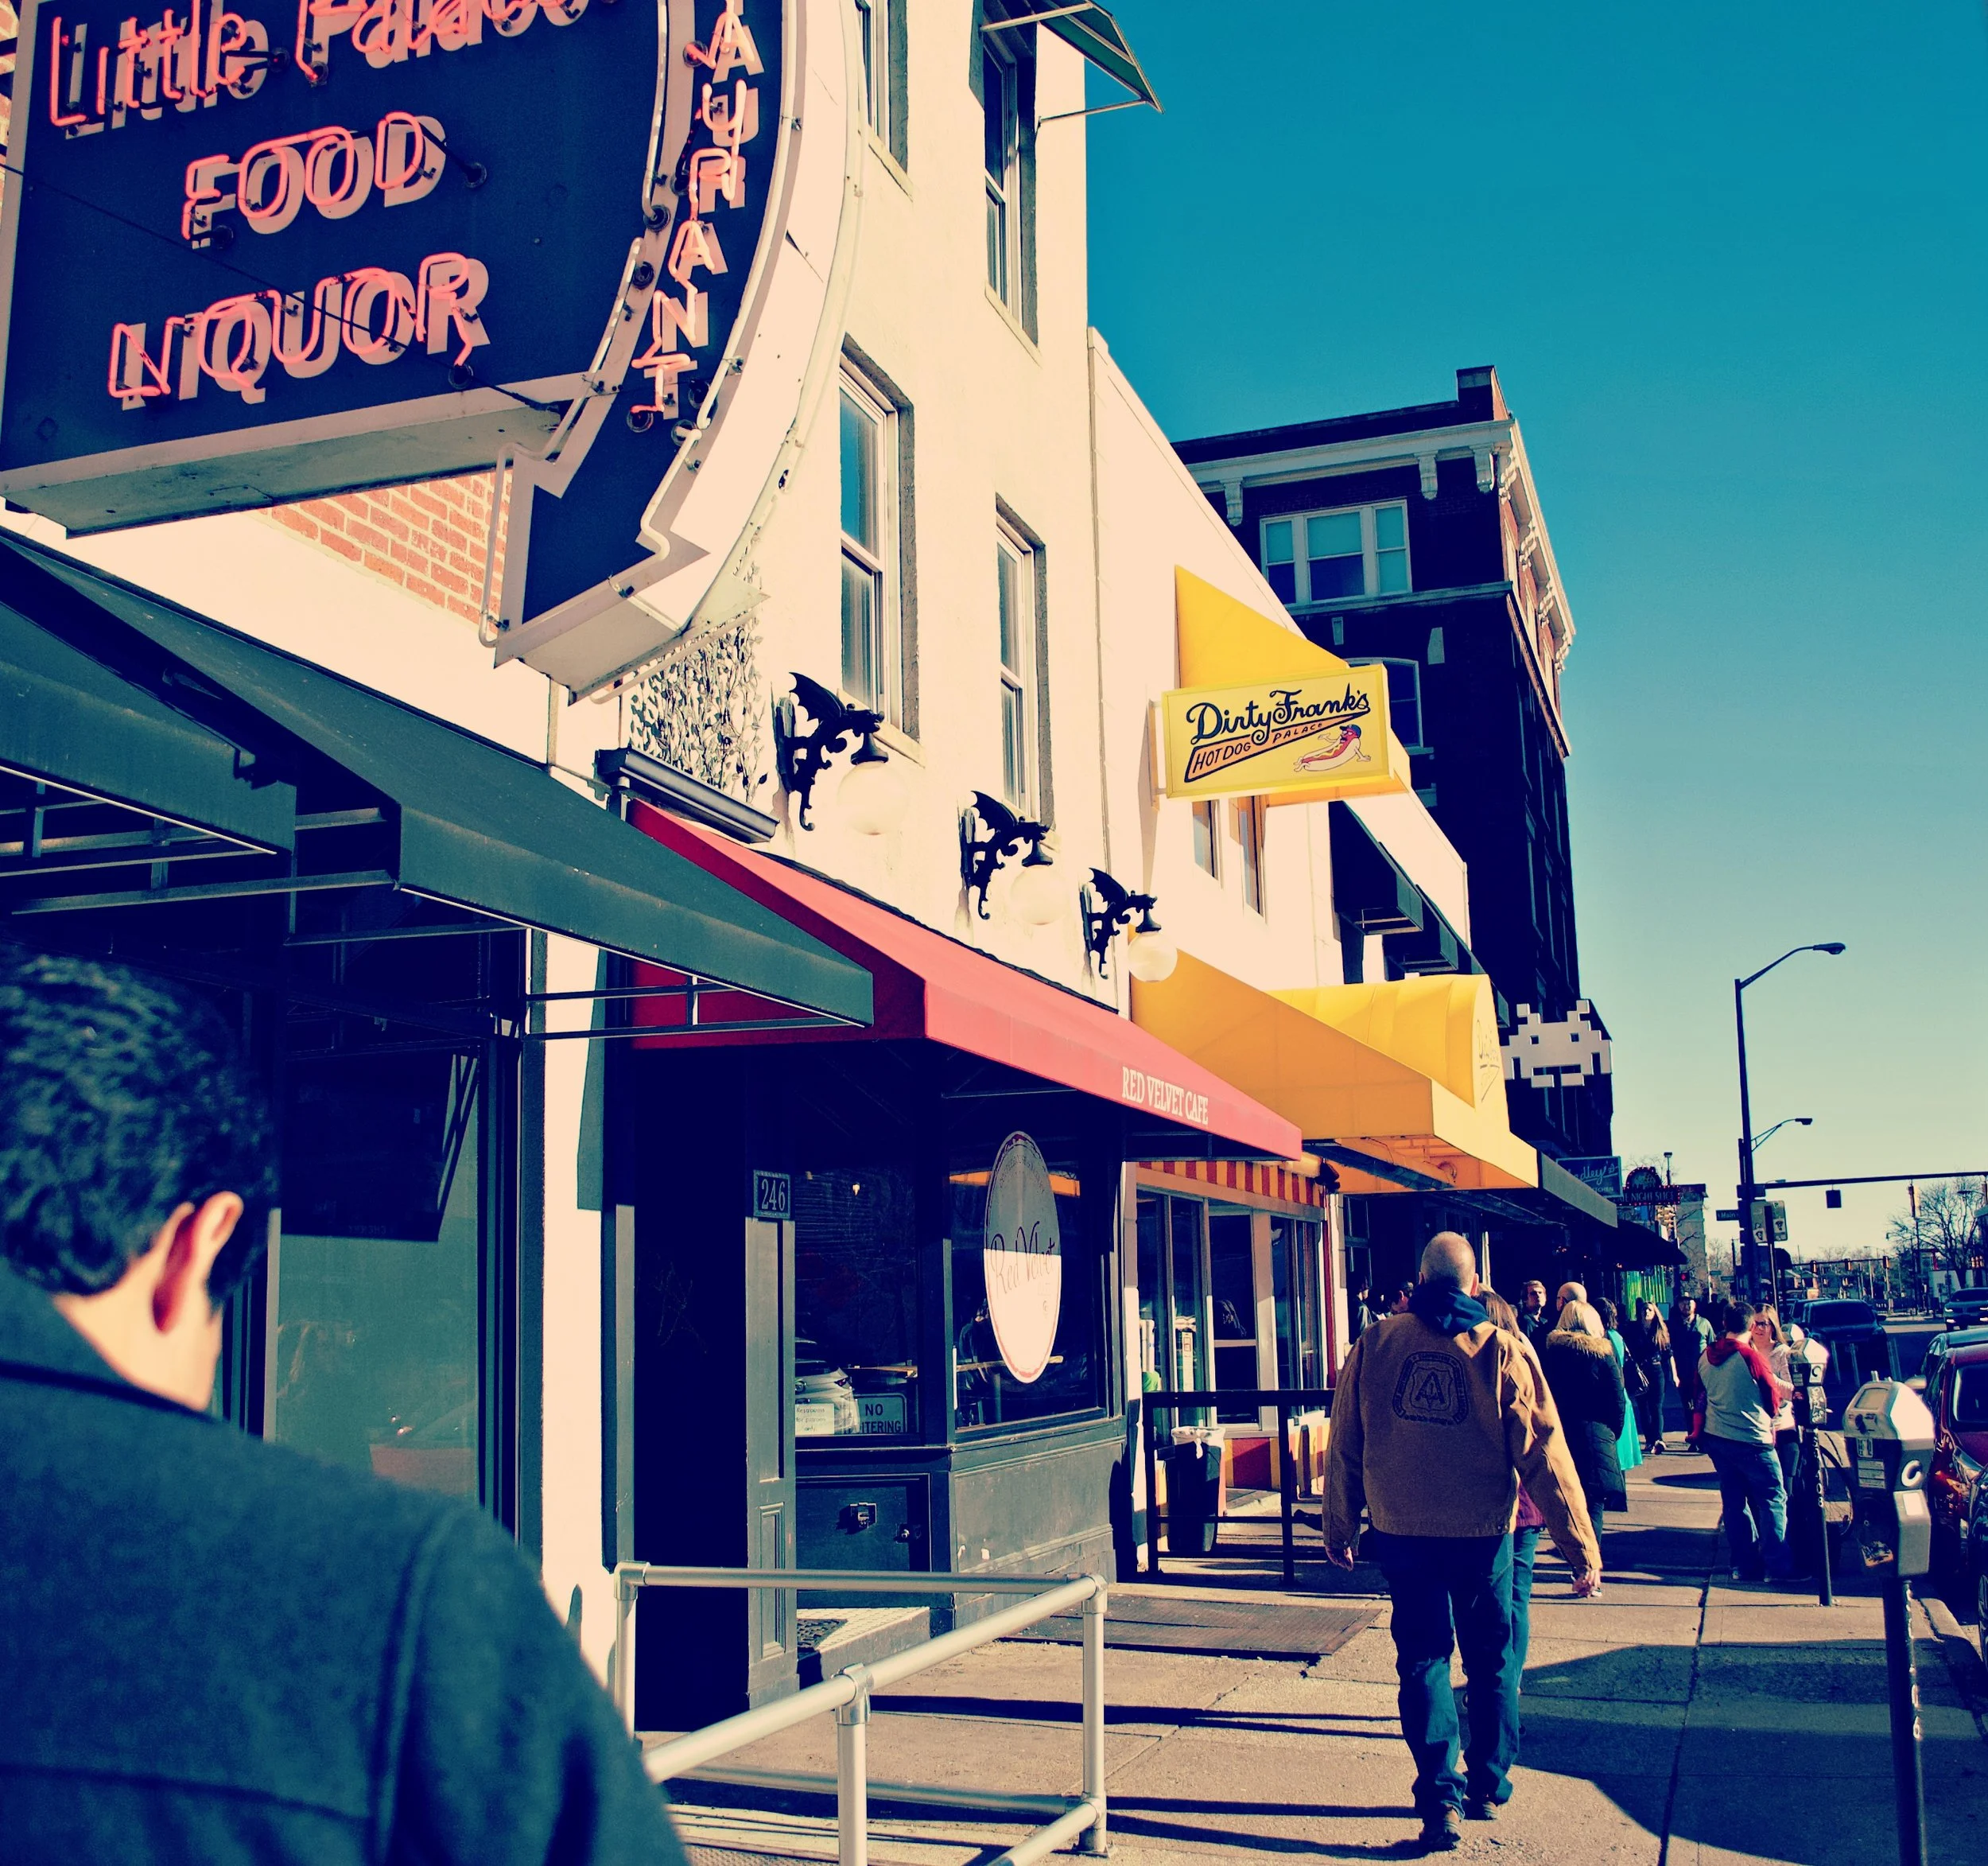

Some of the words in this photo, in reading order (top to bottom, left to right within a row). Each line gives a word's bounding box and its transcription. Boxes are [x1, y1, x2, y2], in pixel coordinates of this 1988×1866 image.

[50, 0, 269, 140] Little
[181, 111, 447, 250] FOOD
[631, 0, 765, 420] AURANT
[1186, 700, 1272, 746] Dirty
[1269, 682, 1370, 725] Frank's
[1272, 722, 1323, 744] PALACE
[1121, 1066, 1146, 1104] RED
[1146, 1075, 1185, 1118] VELVET
[1185, 1090, 1209, 1125] CAFE
[761, 1178, 786, 1211] 246
[1568, 1160, 1617, 1185] dley's
[860, 1420, 902, 1433] ITERING
[864, 1403, 884, 1417] NO
